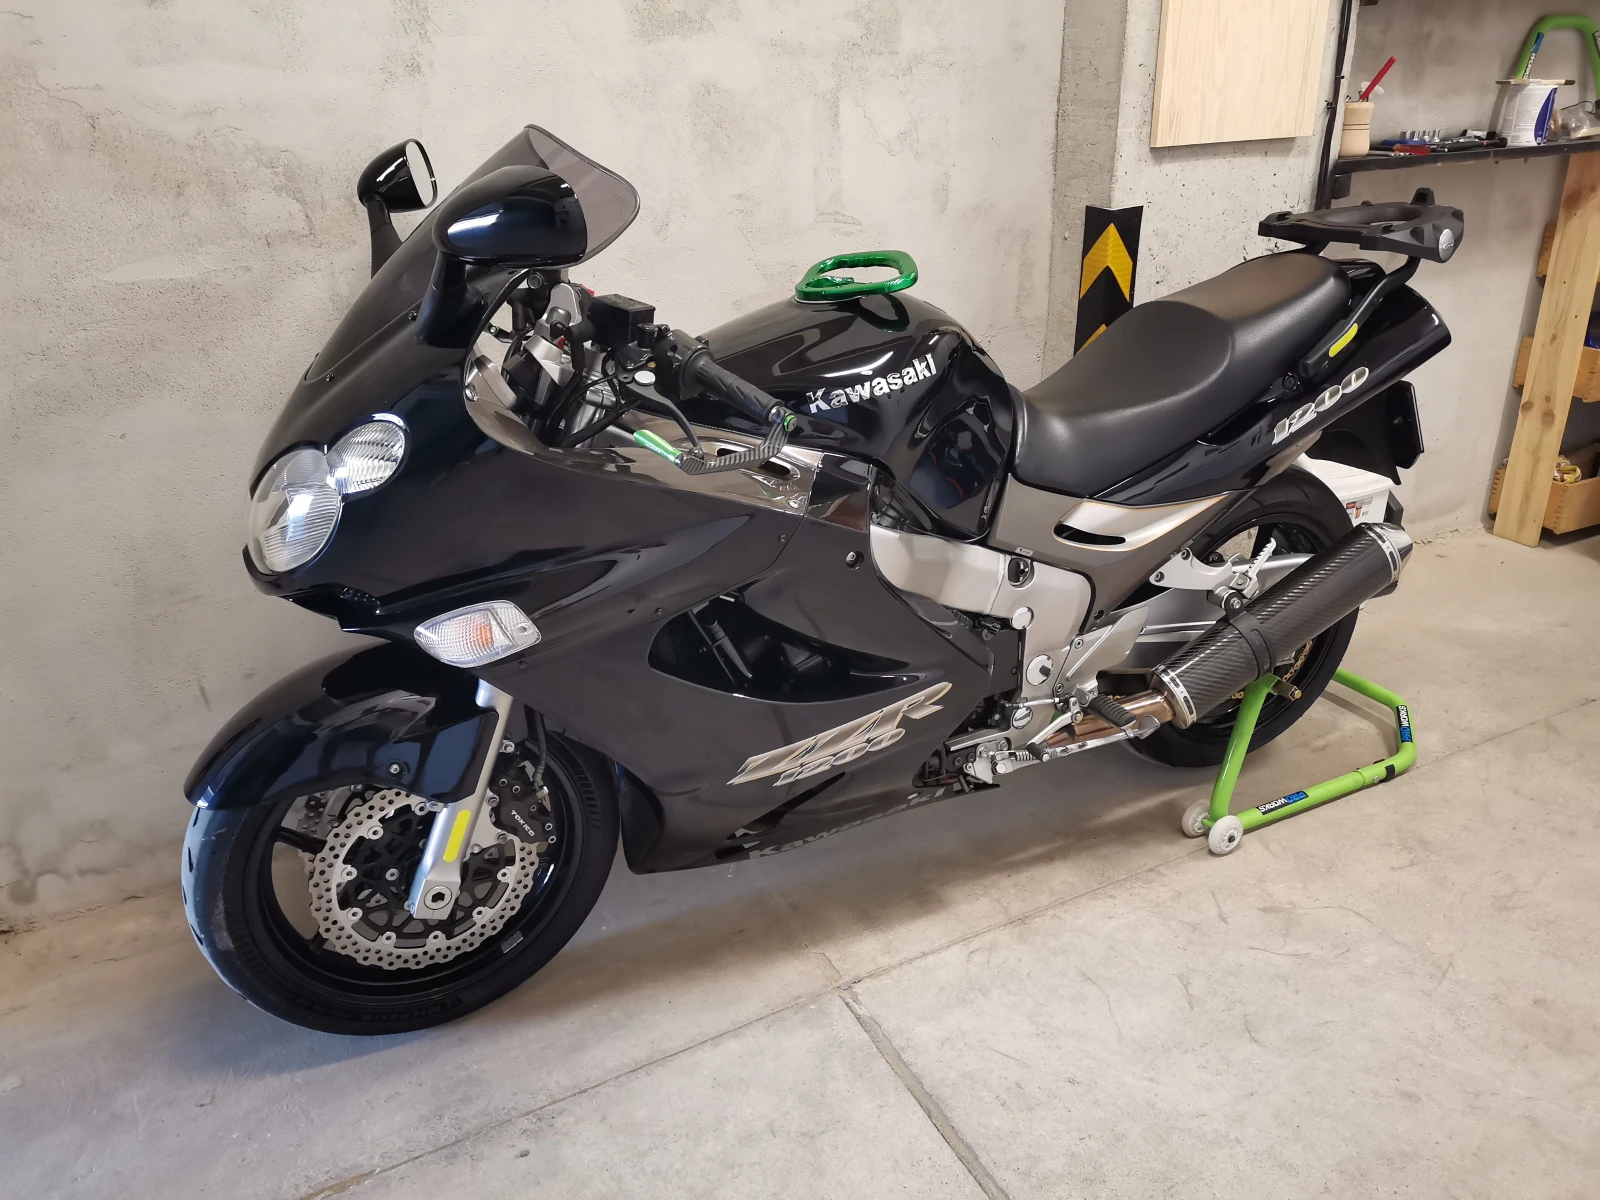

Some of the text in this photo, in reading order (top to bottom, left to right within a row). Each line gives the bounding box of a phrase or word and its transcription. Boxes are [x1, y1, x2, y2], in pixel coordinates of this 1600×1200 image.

[806, 353, 937, 414] Kawasaki
[1272, 366, 1370, 446] 1200
[511, 810, 535, 836] TOKICO
